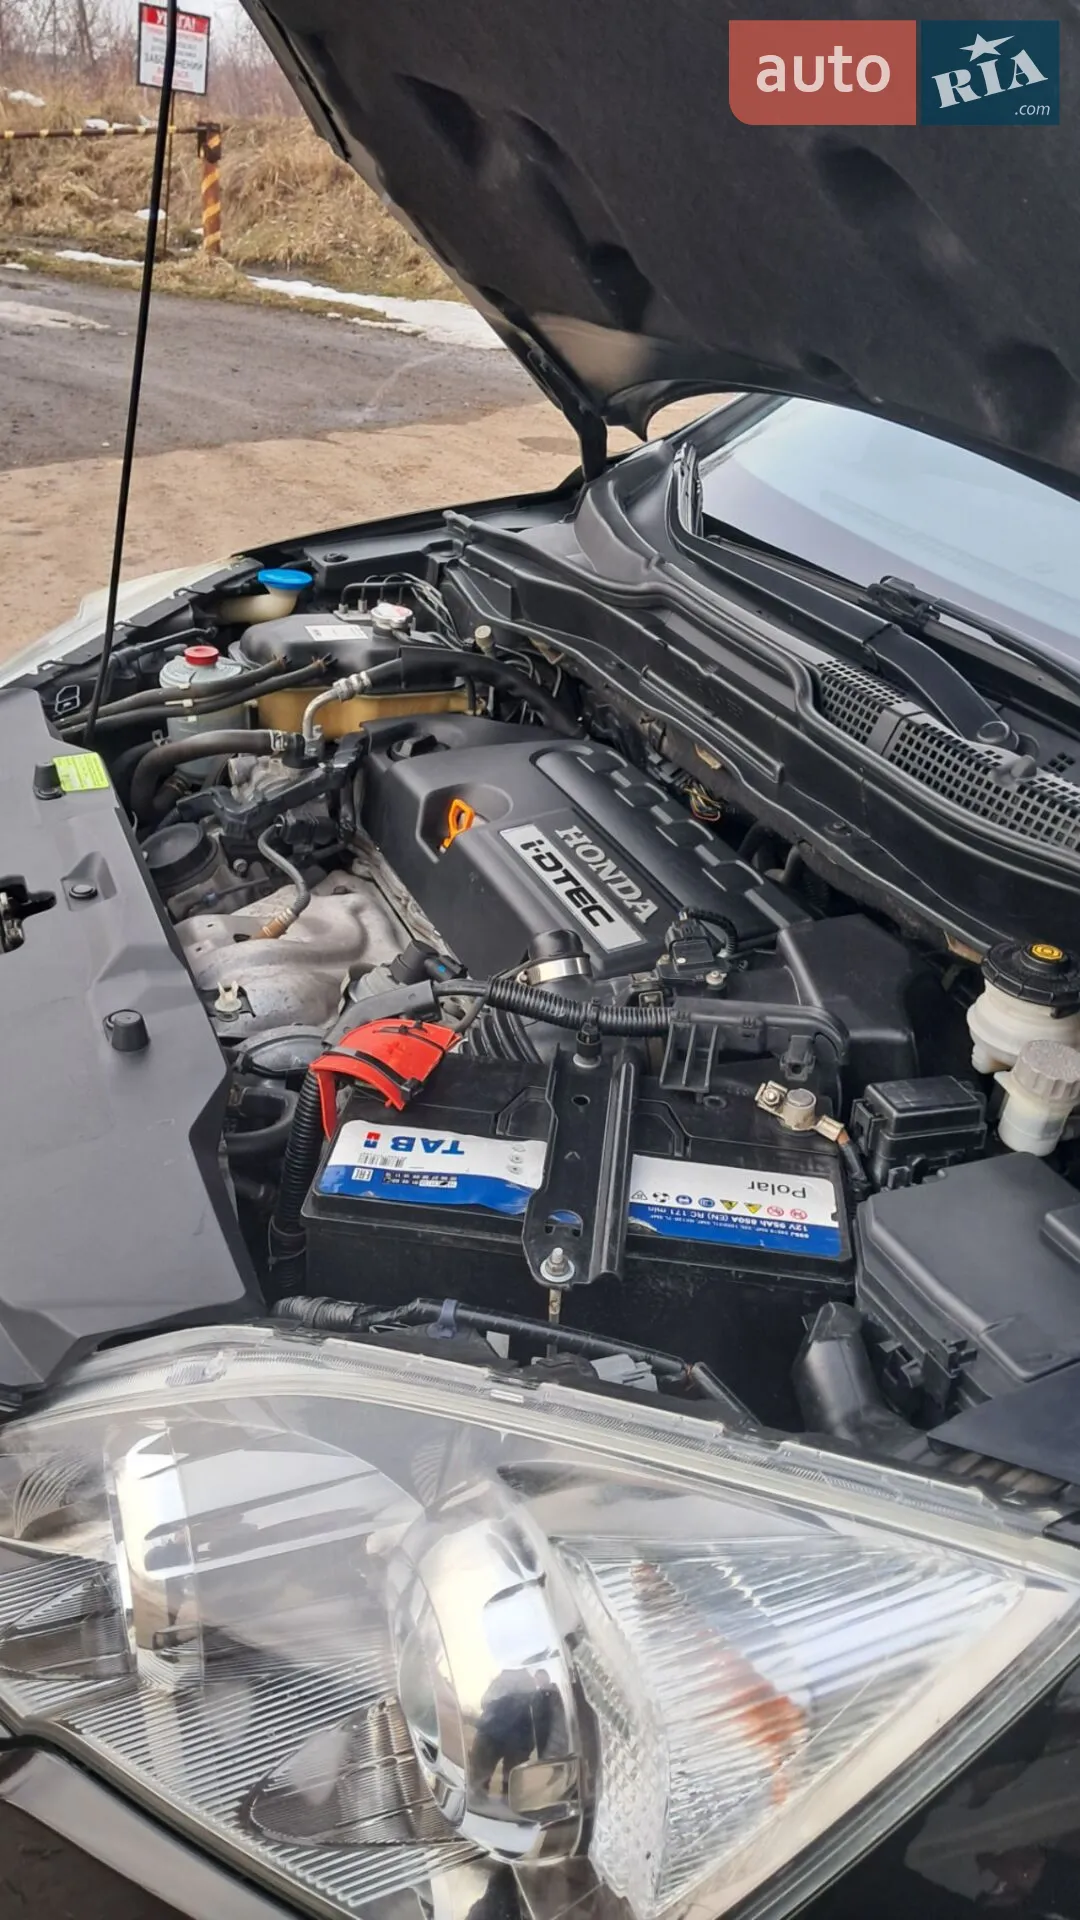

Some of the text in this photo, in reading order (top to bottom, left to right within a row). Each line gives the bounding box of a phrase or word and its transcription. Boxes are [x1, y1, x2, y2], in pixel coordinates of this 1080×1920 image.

[555, 825, 658, 923] HONDA
[520, 839, 615, 927] i-DTEC
[391, 1136, 465, 1155] TAB
[749, 1181, 807, 1198] Polar
[648, 1205, 667, 1214] min
[670, 1208, 687, 1216] 171
[690, 1210, 705, 1219] RC
[707, 1212, 729, 1223] (EN)
[760, 1220, 786, 1230] 95Ah
[789, 1223, 808, 1232] 12V
